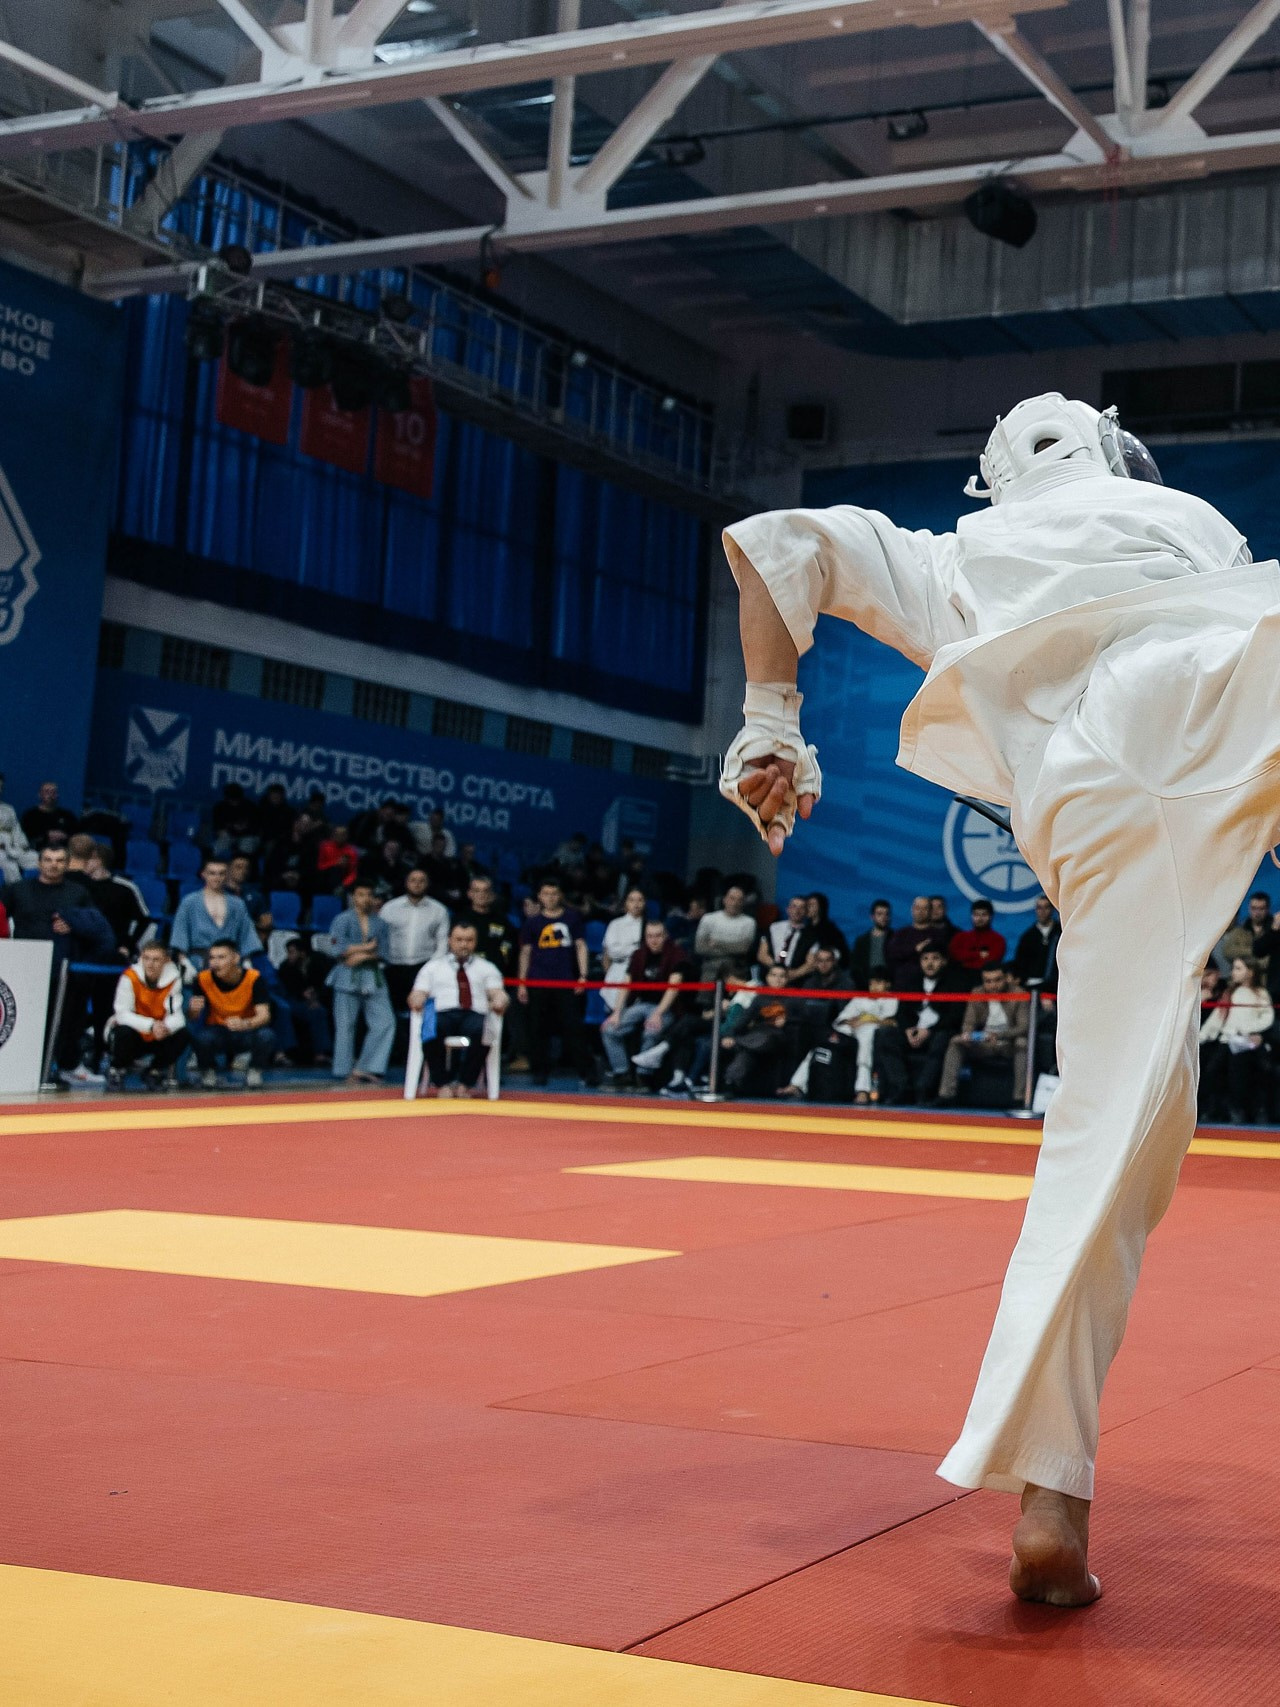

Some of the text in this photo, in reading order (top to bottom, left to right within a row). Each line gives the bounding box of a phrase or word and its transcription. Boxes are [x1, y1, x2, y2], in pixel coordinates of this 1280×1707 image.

[214, 729, 555, 810] МИНИСТЕРСТВО СПОРТА
[443, 800, 510, 830] КРАЯ
